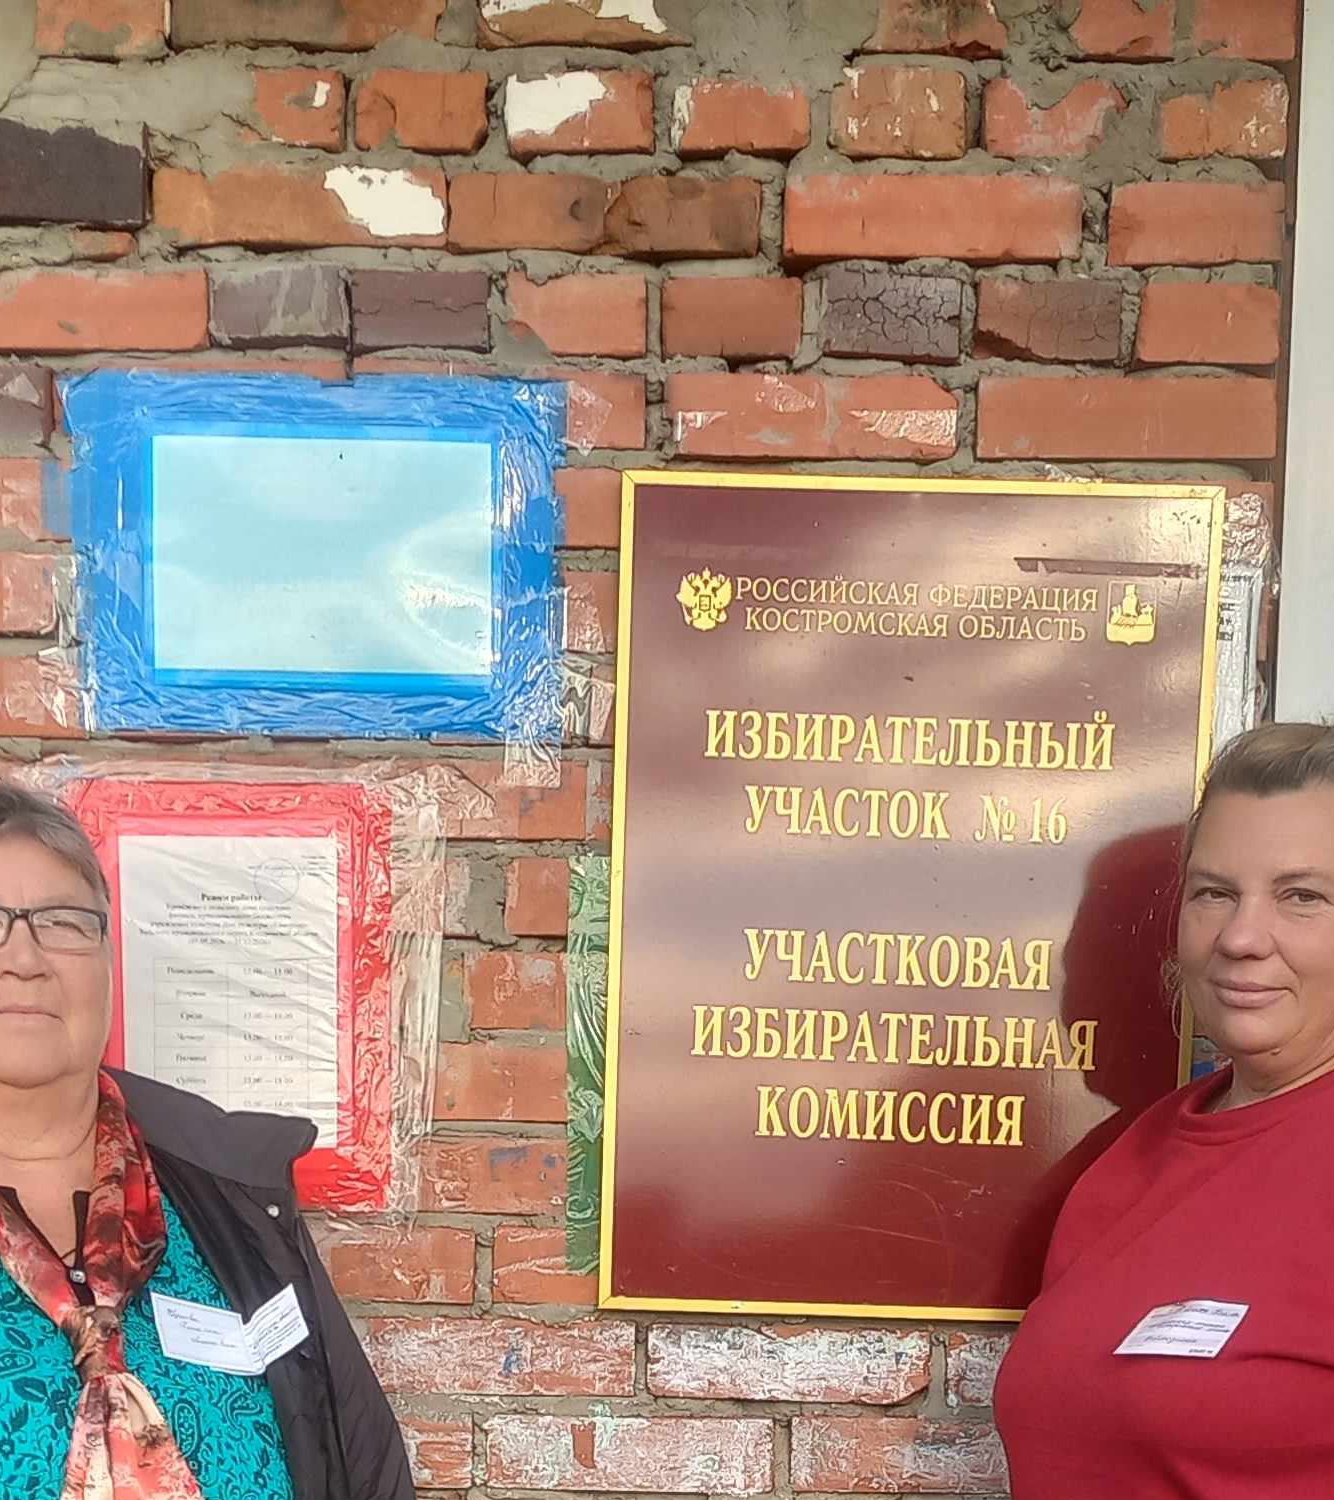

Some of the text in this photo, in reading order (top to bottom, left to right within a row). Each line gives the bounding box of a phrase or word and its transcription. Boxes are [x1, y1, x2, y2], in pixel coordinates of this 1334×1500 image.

[735, 573, 1099, 613] РОССИЙСКАЯ ФЕДЕРАЦИЯ
[744, 607, 1087, 643] КОСТРОМСКАЯ ОБЛАСТЬ
[703, 709, 1116, 772] ИЗБИРАТЕЛЬНЫЙ
[744, 785, 1068, 845] УЧАСТОК № 16
[743, 928, 1053, 992] УЧАСТКОВАЯ
[690, 1005, 1100, 1072] ИЗБИРАТЕЛЬНАЯ
[754, 1085, 1025, 1146] КОМИССИЯ
